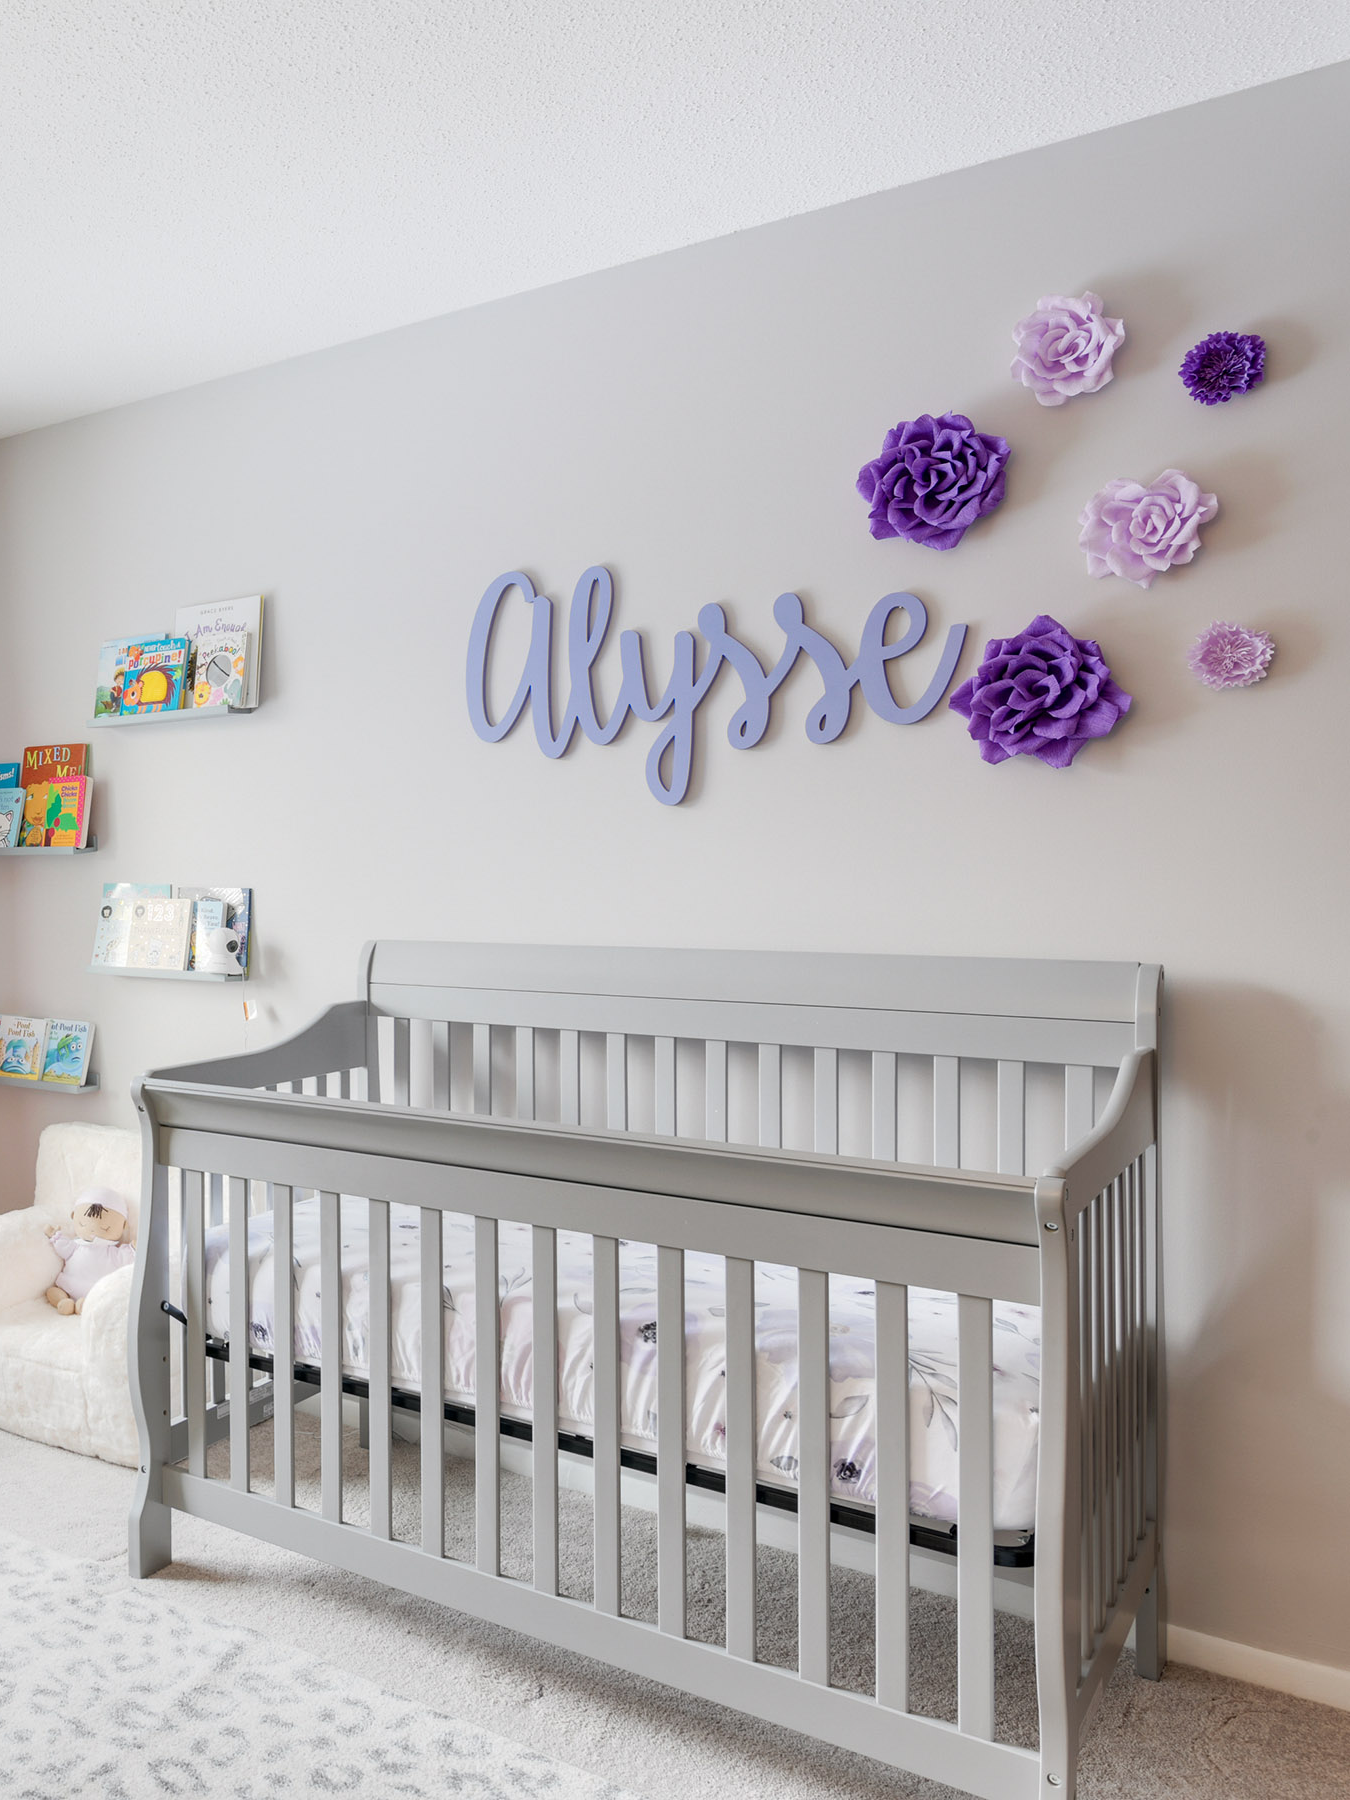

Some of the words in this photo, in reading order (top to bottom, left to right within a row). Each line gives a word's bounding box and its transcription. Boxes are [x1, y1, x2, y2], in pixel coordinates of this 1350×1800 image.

[193, 623, 213, 638] Am
[466, 565, 968, 806] Alysse
[26, 746, 71, 770] MIXED
[147, 903, 175, 921] 123
